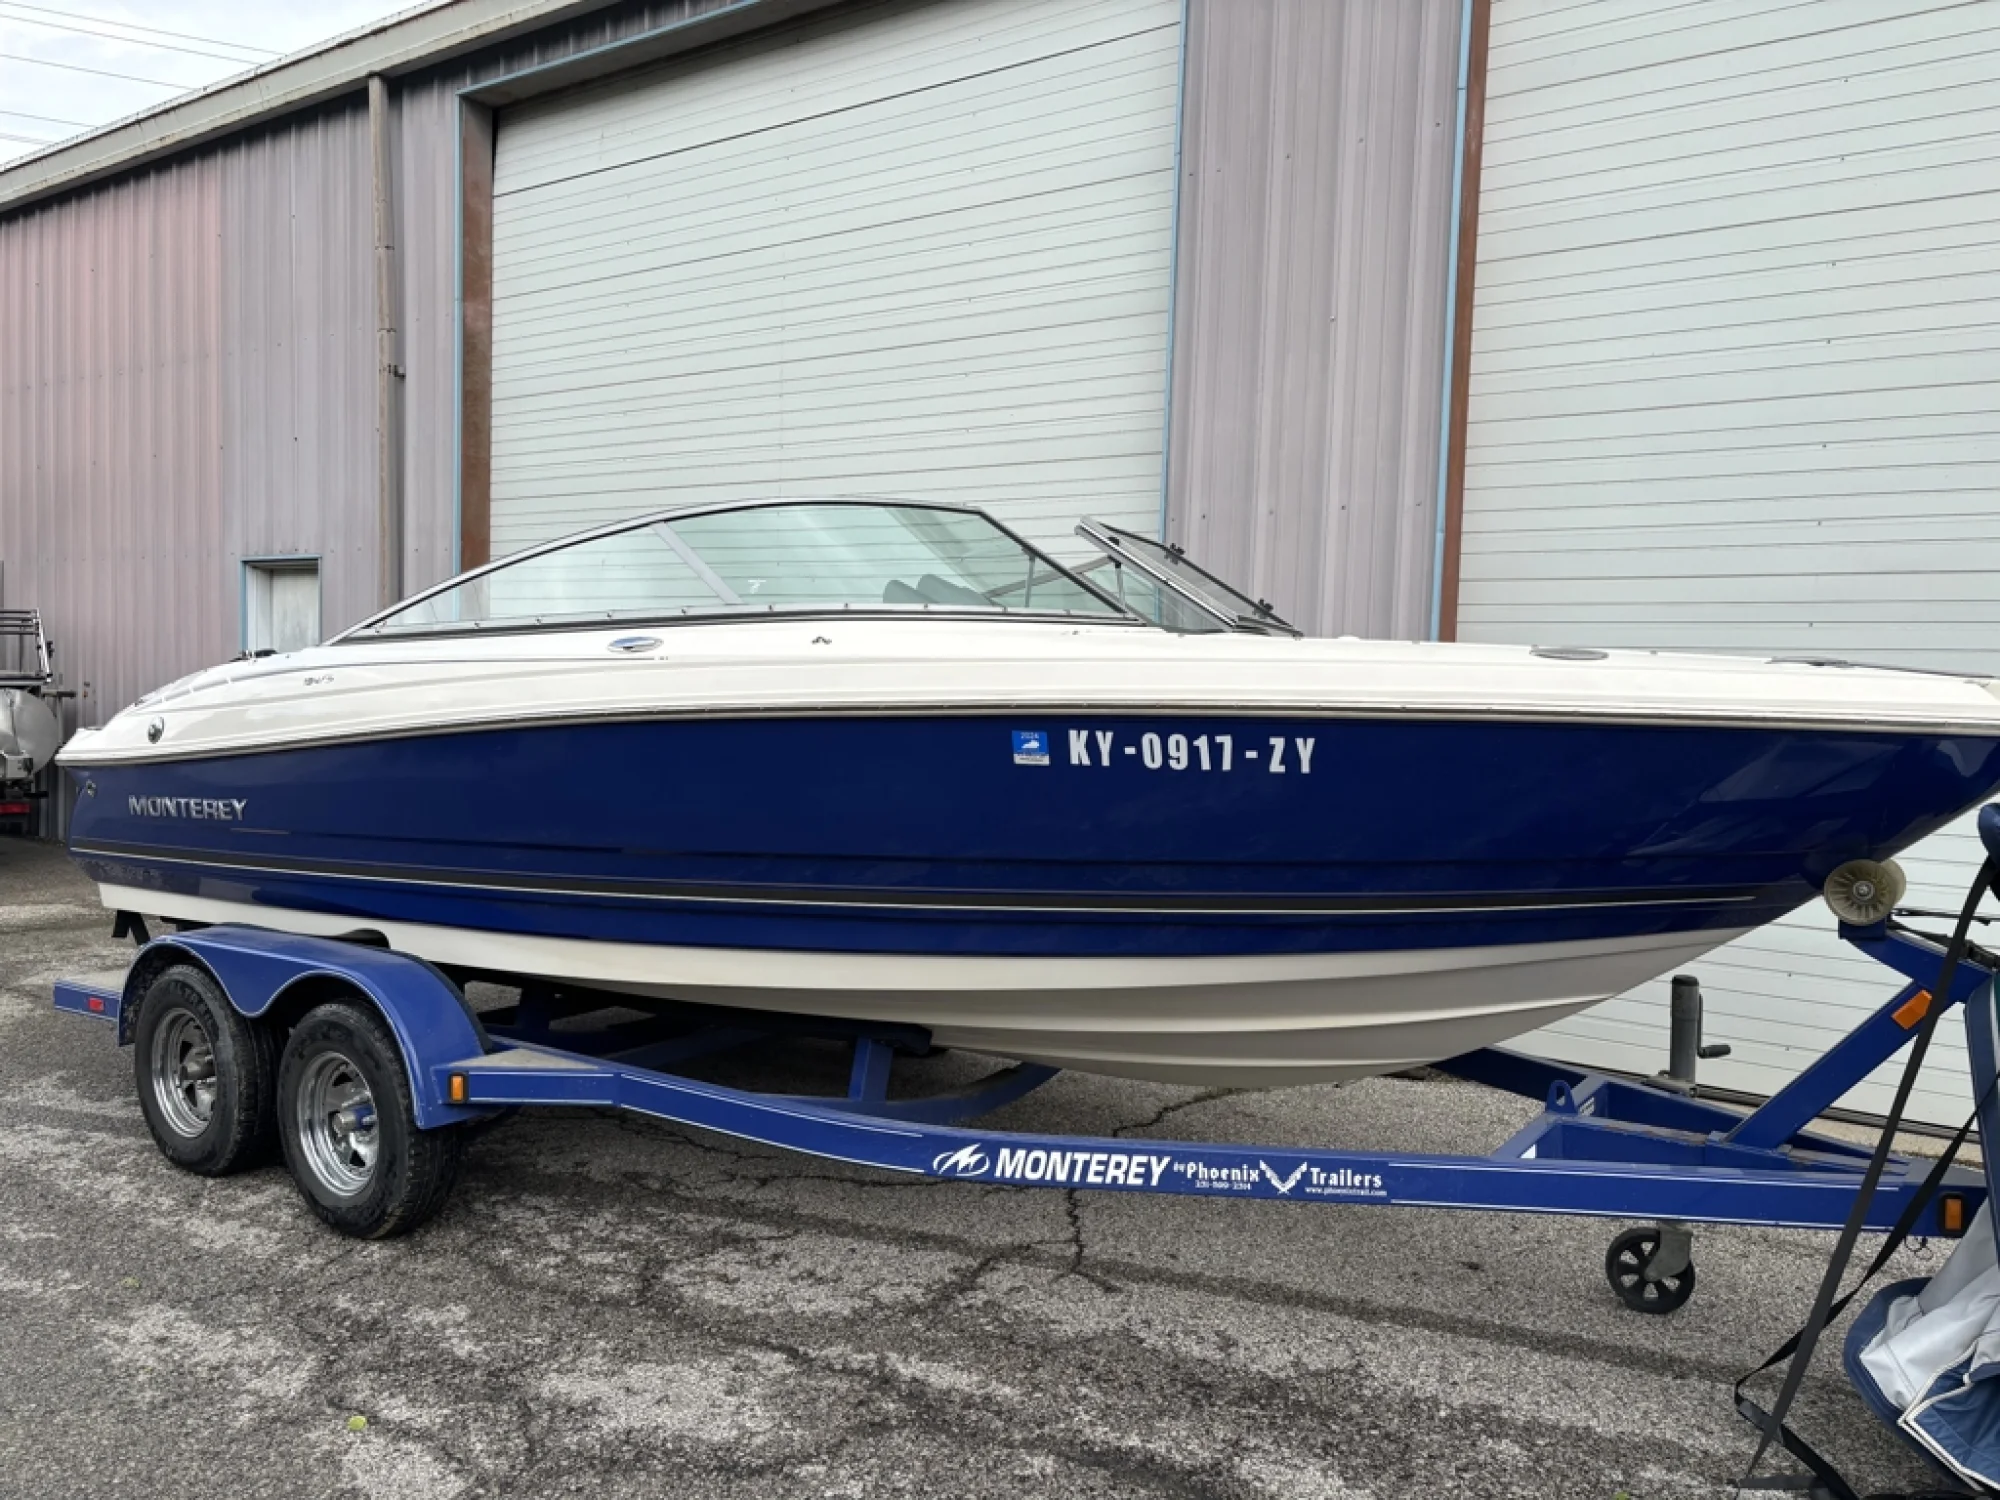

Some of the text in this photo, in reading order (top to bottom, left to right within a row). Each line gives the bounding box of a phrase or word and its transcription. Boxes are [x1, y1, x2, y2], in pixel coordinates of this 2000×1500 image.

[1068, 729, 1316, 774] KY-0917-ZY
[128, 795, 248, 821] MONTEREY
[995, 1148, 1171, 1186] MONTEREY
[1186, 1161, 1260, 1182] Phoenix
[1310, 1167, 1383, 1189] Trailers
